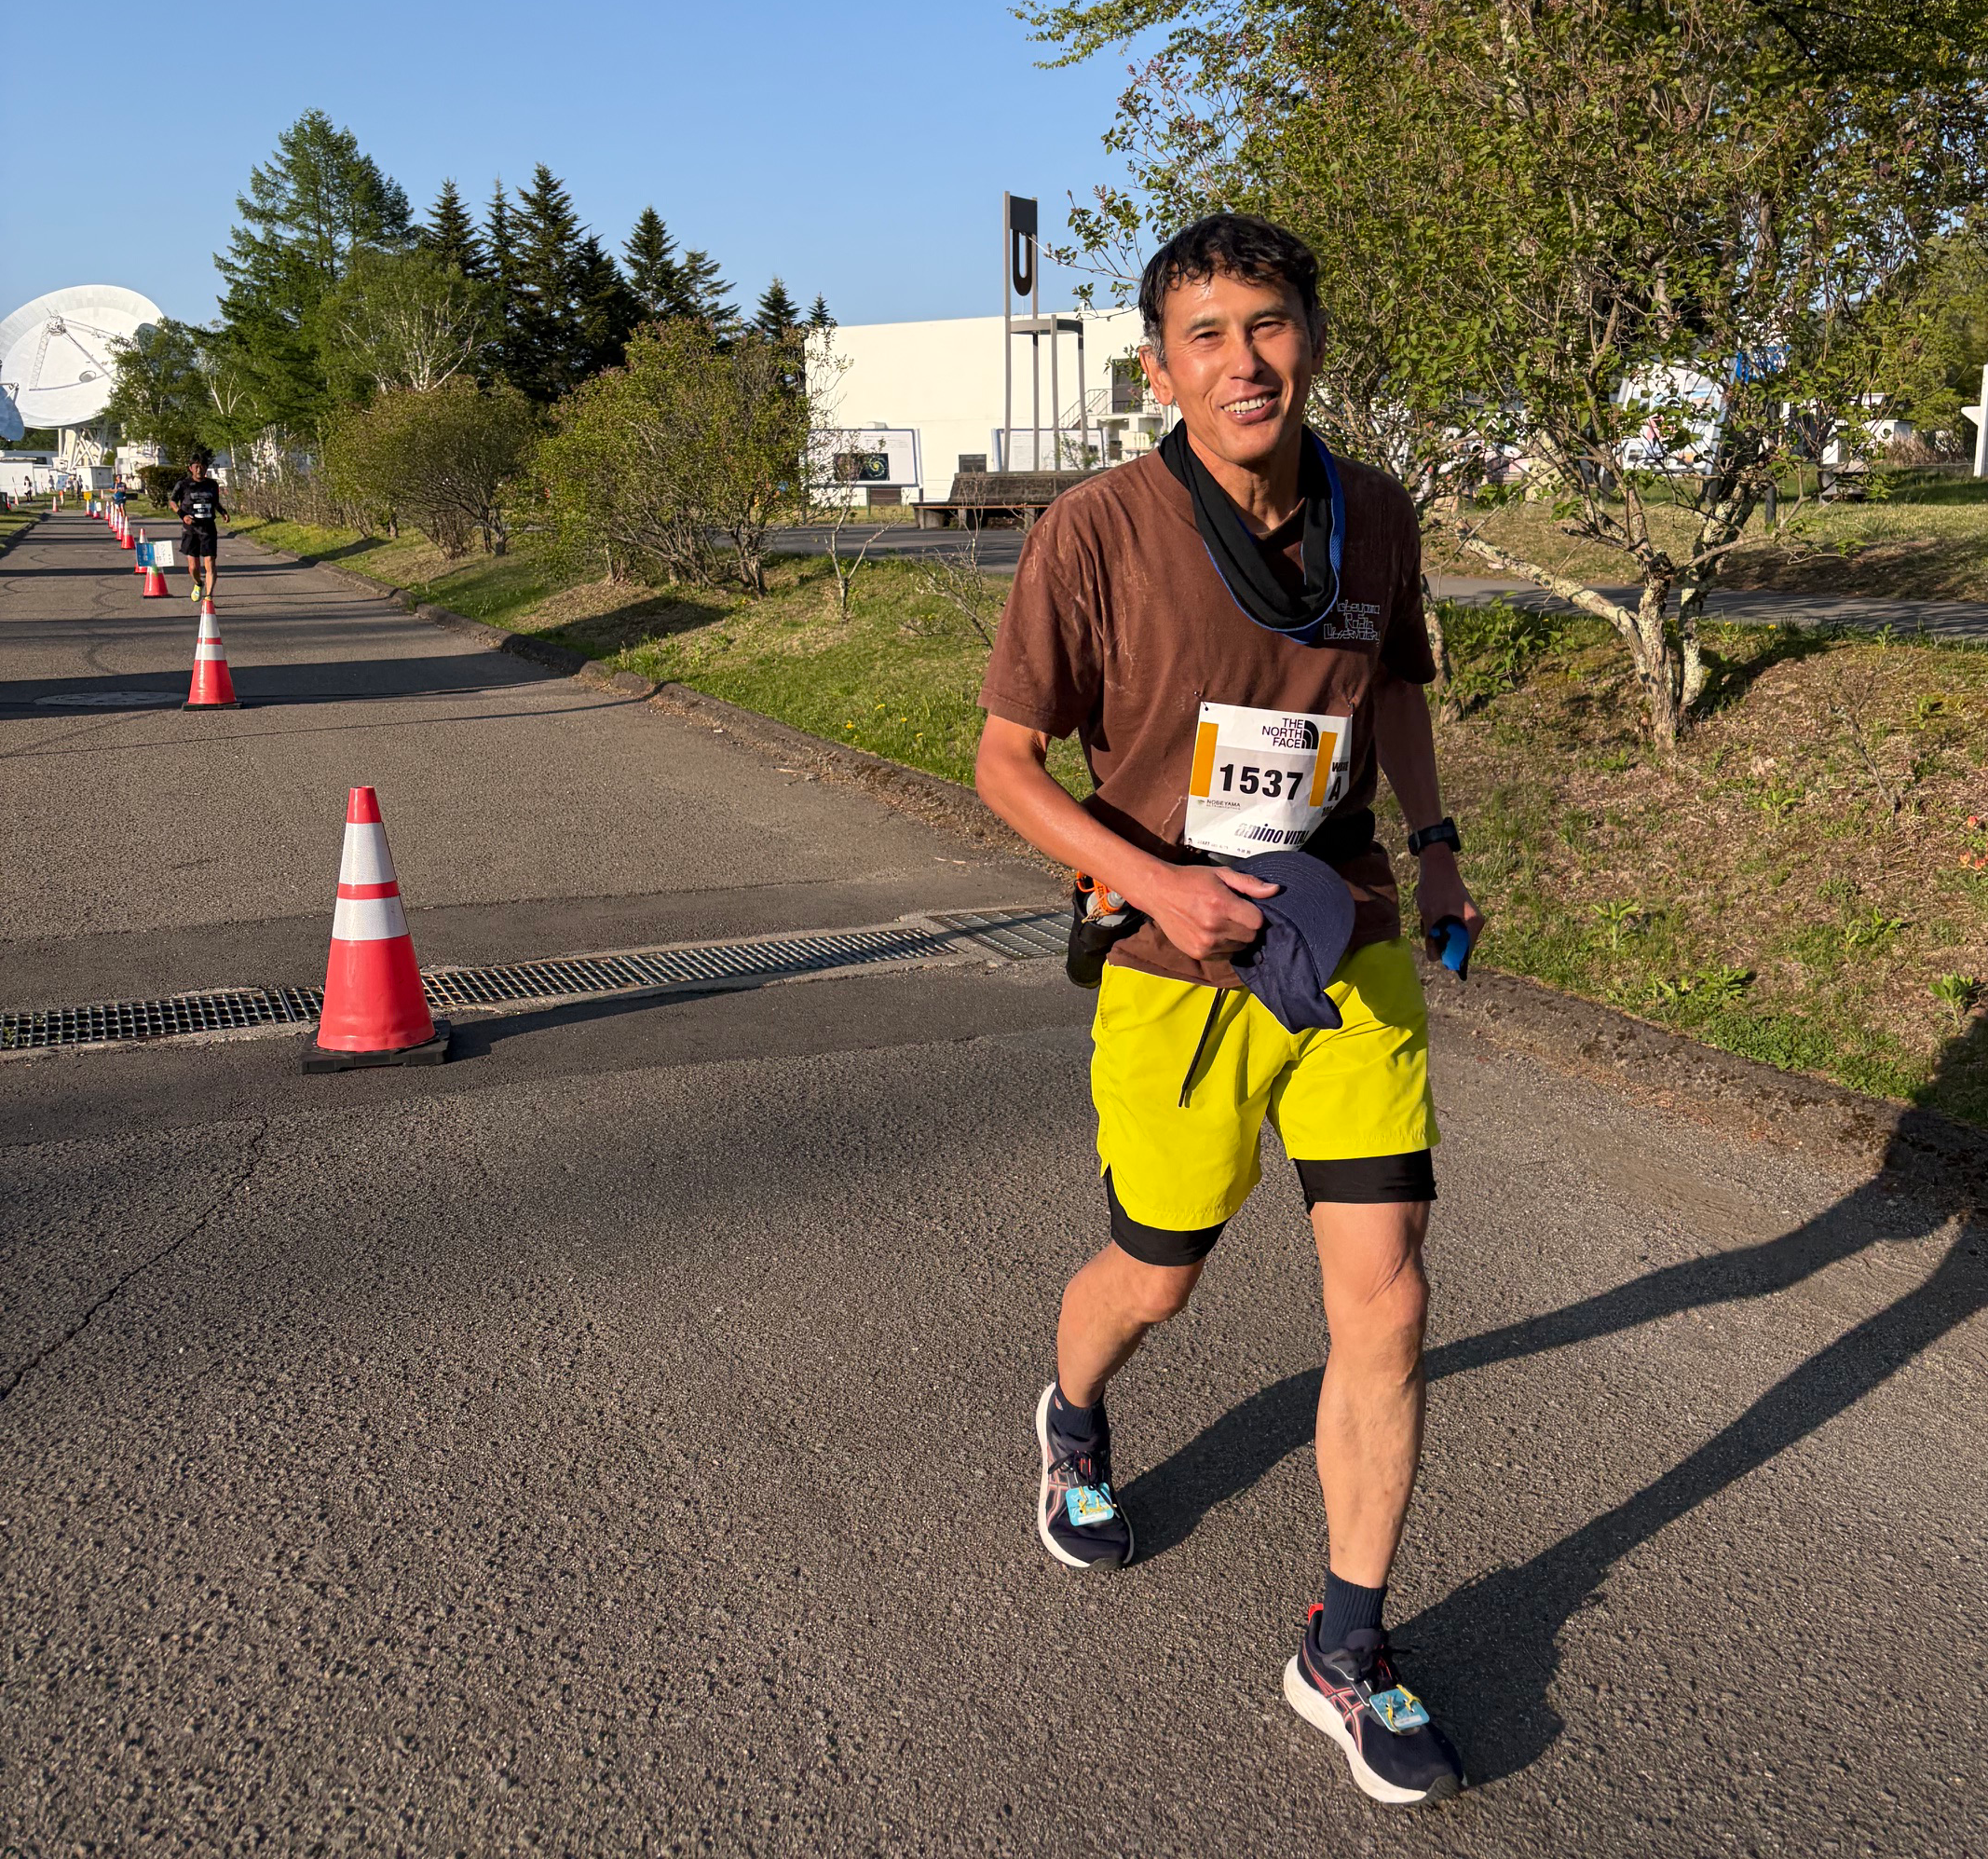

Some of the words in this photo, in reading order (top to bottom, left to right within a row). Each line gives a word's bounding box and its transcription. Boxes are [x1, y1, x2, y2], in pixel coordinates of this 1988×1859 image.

[1282, 718, 1304, 730] THE
[1261, 725, 1303, 740] NORTH
[1273, 736, 1301, 749] FACE
[1219, 763, 1304, 800] 1537
[1328, 776, 1341, 801] A
[1206, 799, 1241, 808] NOBEYAMA
[1234, 823, 1284, 844] amino
